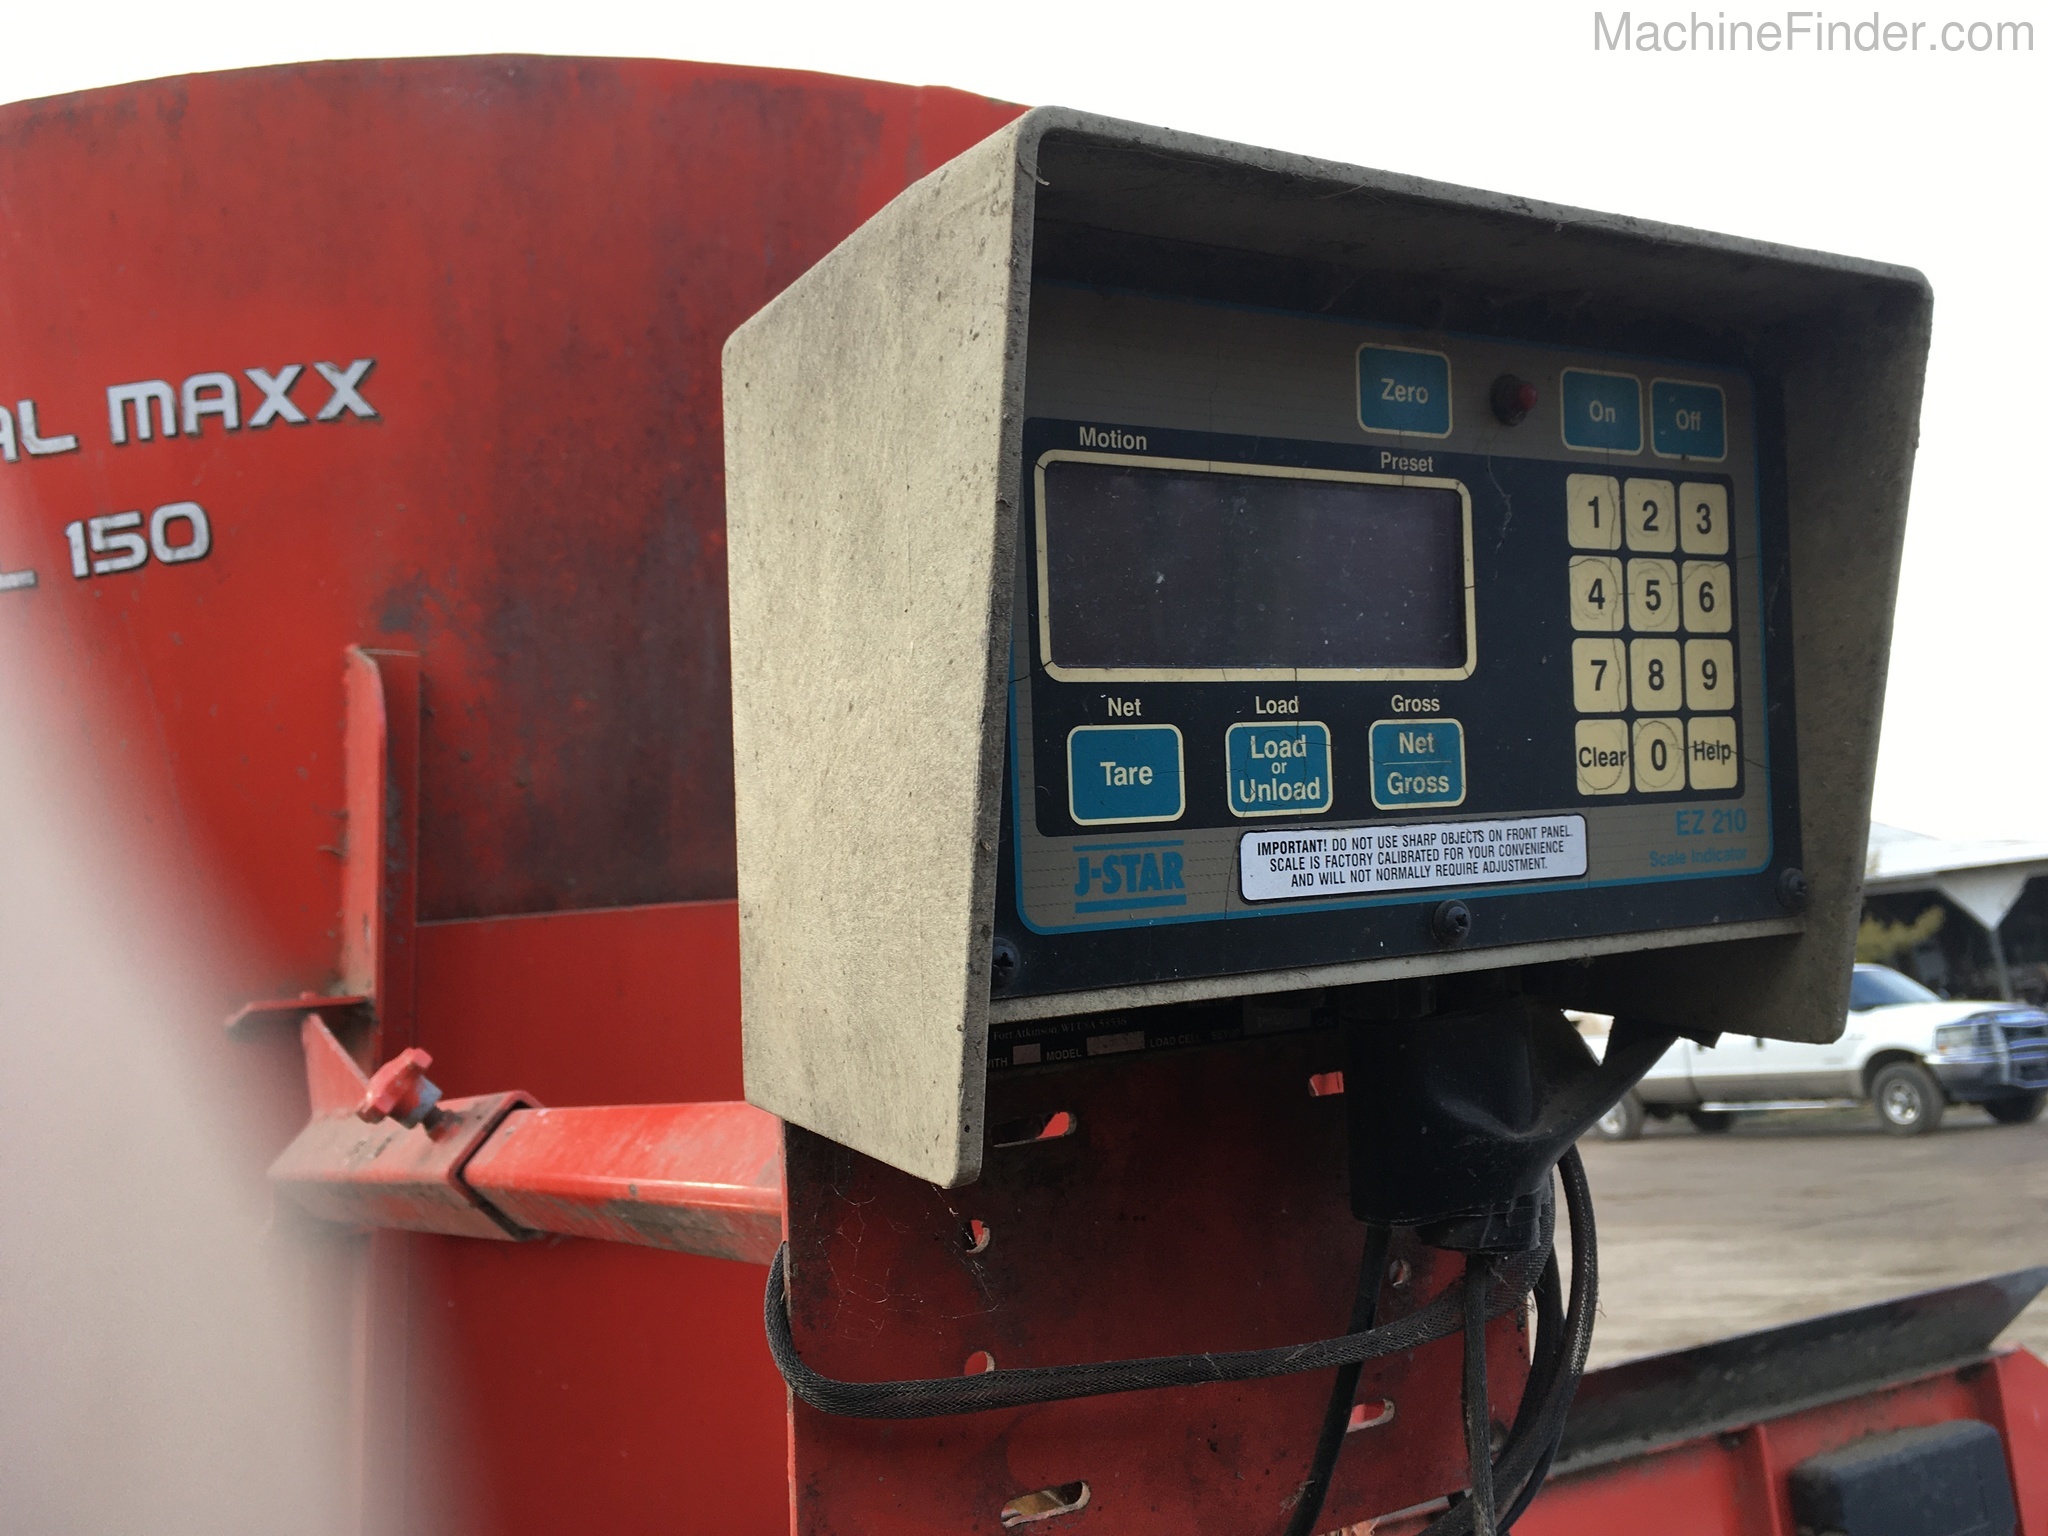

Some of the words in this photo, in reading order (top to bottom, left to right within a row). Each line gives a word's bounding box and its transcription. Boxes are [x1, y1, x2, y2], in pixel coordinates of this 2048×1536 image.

[106, 358, 379, 445] MAXX
[1380, 377, 1429, 404] Zero
[1589, 400, 1616, 424] On
[1676, 408, 1702, 431] Off
[1078, 426, 1148, 451] Motion
[1380, 451, 1434, 473] Preset
[1587, 496, 1601, 529] 1
[1642, 499, 1659, 532] 2
[1696, 503, 1712, 535] 3
[65, 501, 212, 579] 150
[1588, 578, 1605, 610] 4
[1645, 580, 1661, 612] 5
[1699, 581, 1715, 613] 6
[1590, 659, 1608, 691] 7
[1648, 658, 1664, 691] 8
[1702, 658, 1717, 691] 9
[1107, 696, 1142, 718] Net
[1255, 695, 1300, 715] Load
[1391, 694, 1441, 713] Gross
[1250, 735, 1307, 760] Load
[1398, 731, 1435, 755] Net
[1651, 738, 1667, 772] 0
[1693, 739, 1732, 766] Help
[1271, 760, 1288, 775] or
[1578, 746, 1627, 768] Clear
[1100, 761, 1153, 787] Tare
[1386, 772, 1450, 796] Gross
[1239, 779, 1321, 804] Unload
[1675, 809, 1705, 836] EZ
[1711, 807, 1748, 834] 210
[1257, 839, 1328, 857] IMPORTANT!
[1332, 838, 1347, 852] DO
[1351, 837, 1373, 851] NOT
[1377, 835, 1398, 850] USE
[1402, 833, 1437, 848] SHARP
[1441, 830, 1485, 845] OBJECTS
[1488, 829, 1502, 843] ON
[1506, 827, 1538, 841] FRONT
[1541, 825, 1574, 839] PANEL.
[1269, 857, 1306, 872] SCALE
[1309, 856, 1321, 870] IS
[1325, 853, 1373, 869] FACTORY
[1377, 849, 1440, 866] CALIBRATED
[1443, 847, 1464, 862] FOR
[1467, 845, 1496, 860] YOUR
[1499, 840, 1565, 858] CONVENIENCE
[1649, 850, 1687, 867] Scale
[1691, 847, 1748, 863] Indicator
[1073, 850, 1185, 898] J-STAR
[1290, 873, 1315, 888] AND
[1318, 871, 1346, 886] WILL
[1349, 869, 1372, 884] NOT
[1375, 865, 1431, 882] NORMALLY
[1435, 862, 1479, 878] REQUIRE
[1482, 857, 1549, 874] ADJUSTMENT.
[993, 1030, 1013, 1041] Fort
[1077, 1020, 1097, 1031] USA
[1046, 1048, 1083, 1062] MODEL
[1149, 1036, 1177, 1048] LOAD
